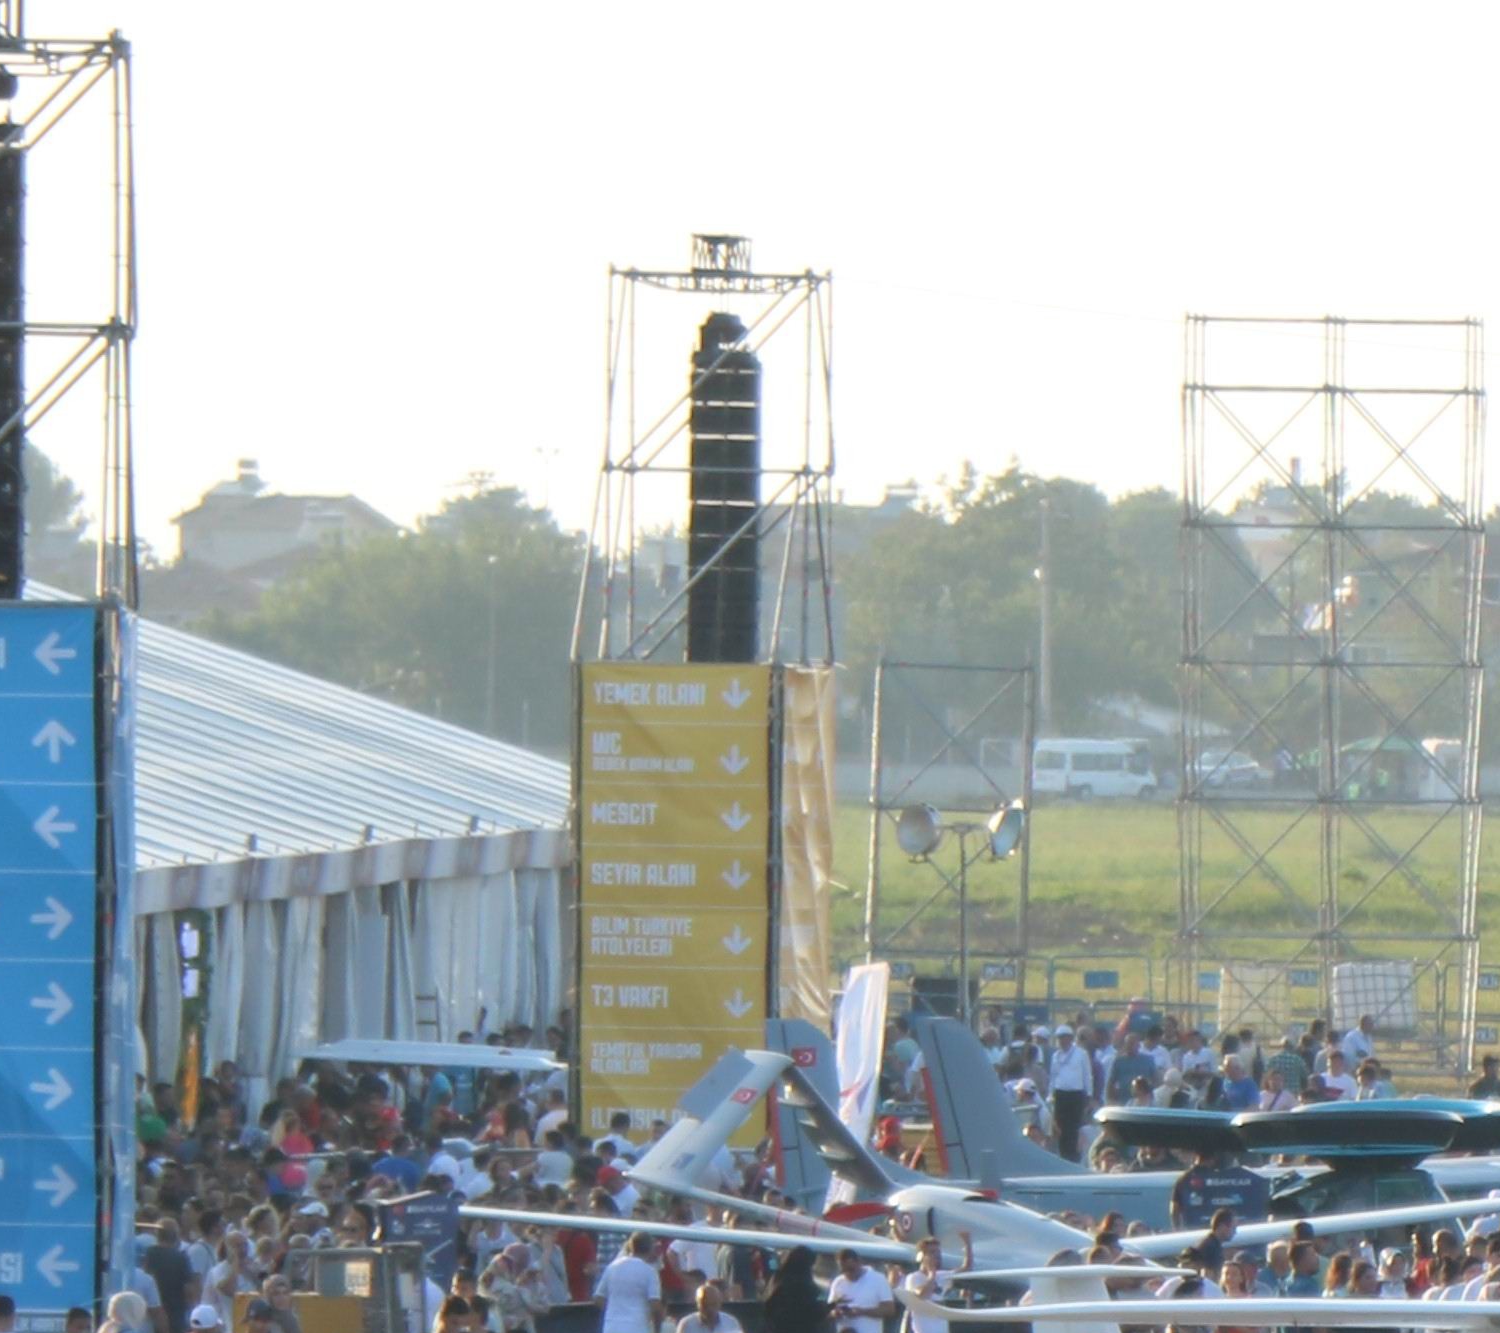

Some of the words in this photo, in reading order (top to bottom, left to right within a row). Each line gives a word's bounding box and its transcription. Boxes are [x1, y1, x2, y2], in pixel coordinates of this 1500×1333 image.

[593, 682, 652, 706] YEMEK
[656, 682, 707, 706] ALANI
[592, 731, 622, 755] WC
[646, 863, 696, 888] ALANI
[591, 984, 615, 1008] T3
